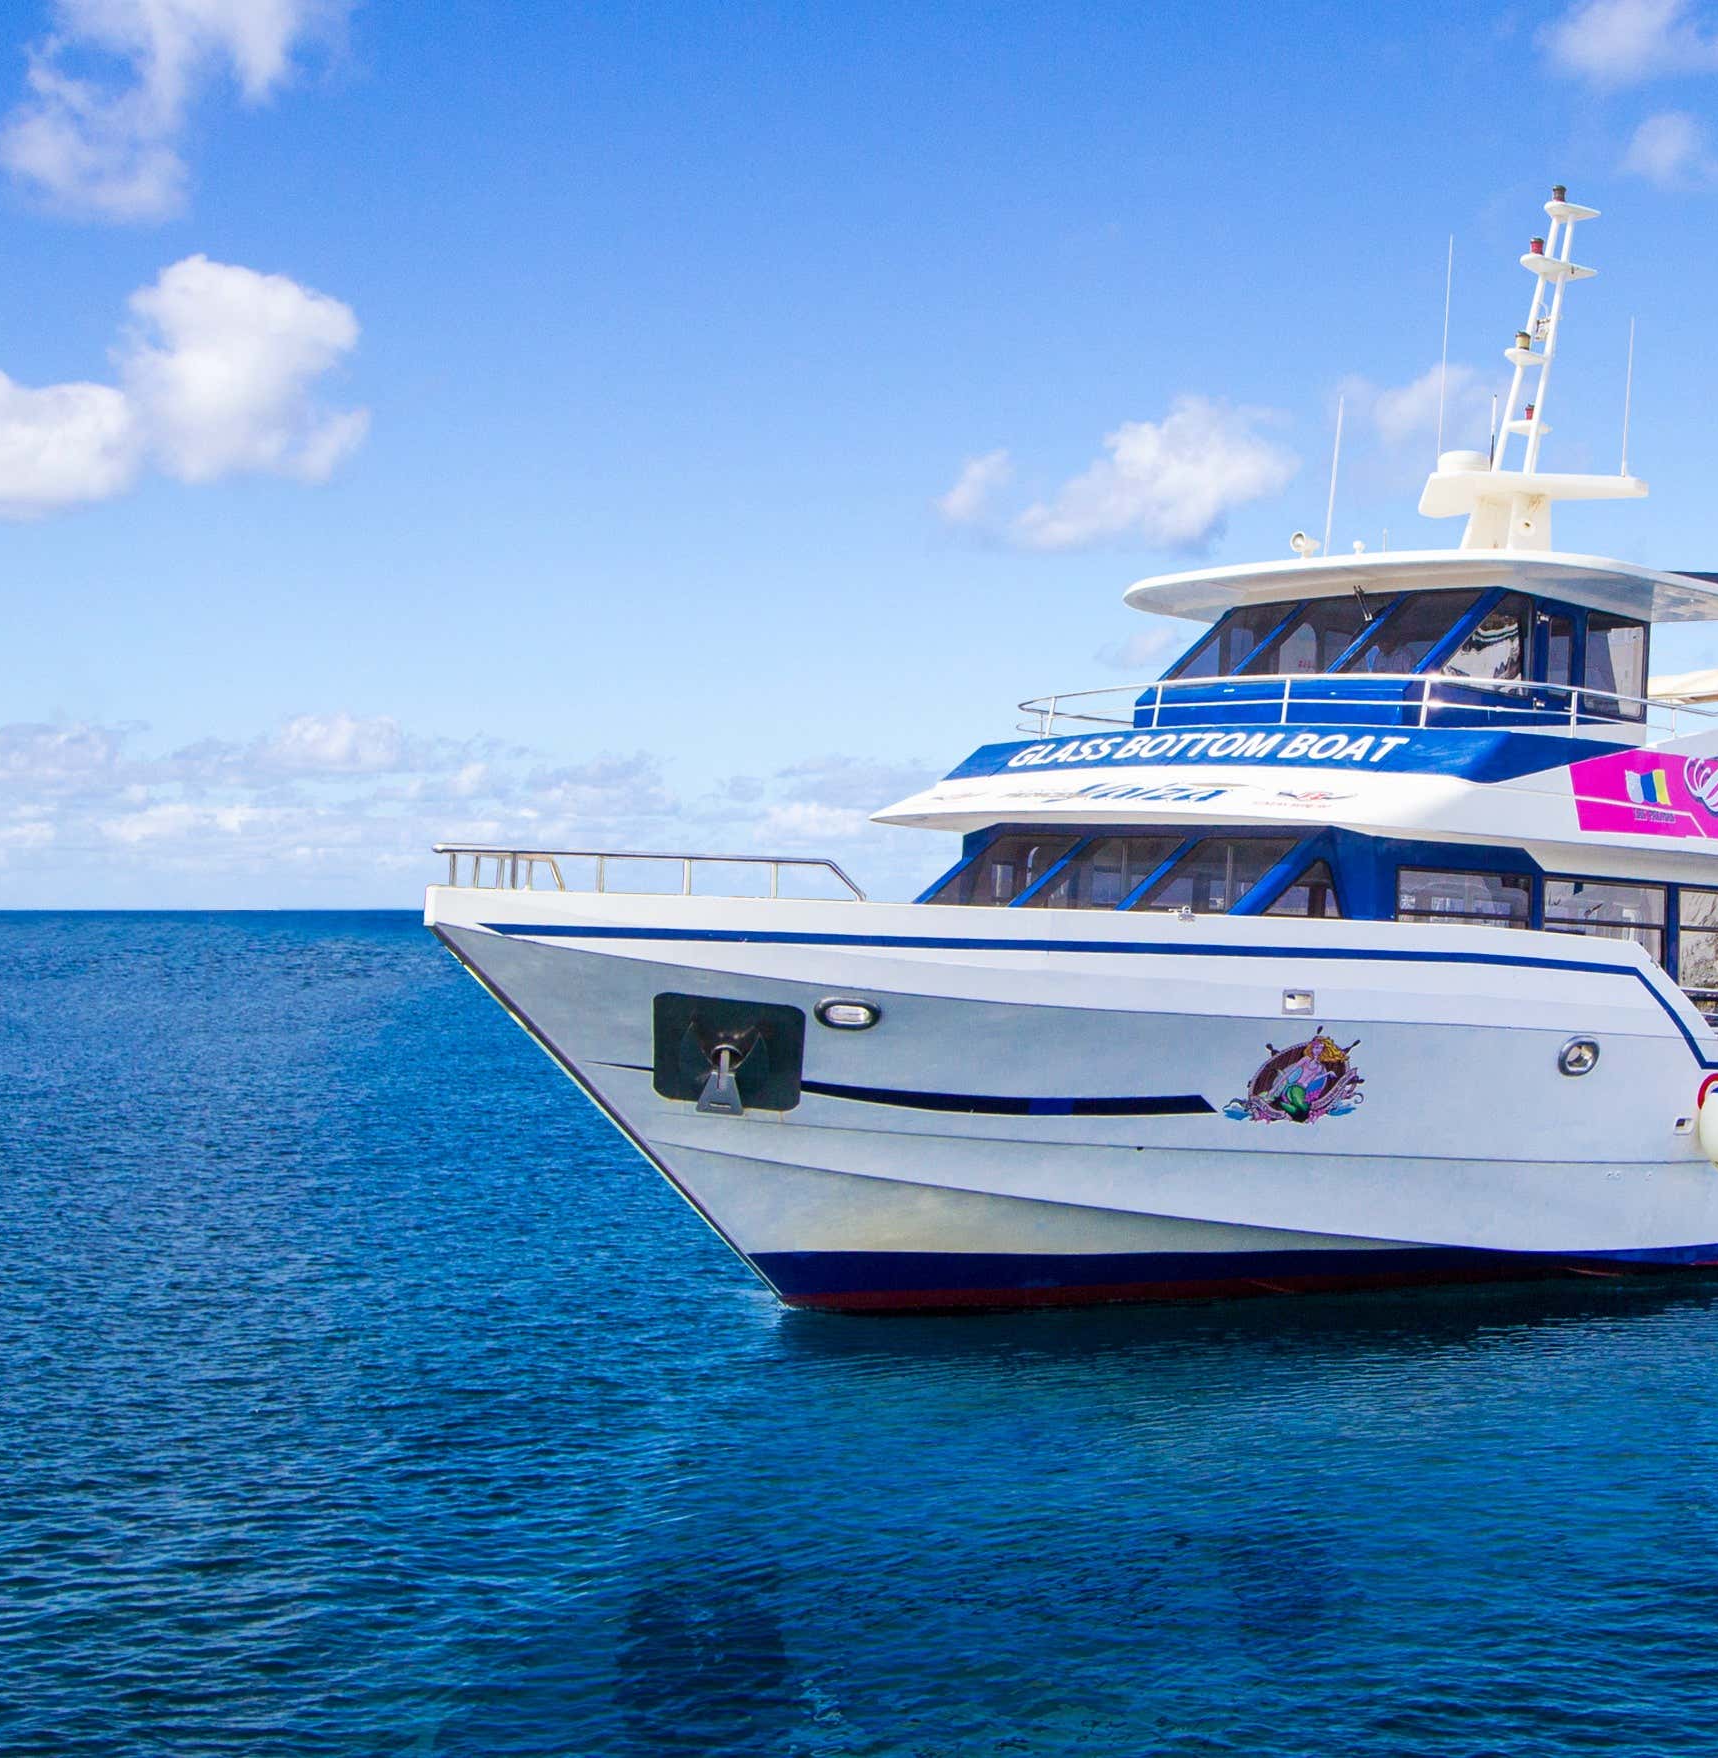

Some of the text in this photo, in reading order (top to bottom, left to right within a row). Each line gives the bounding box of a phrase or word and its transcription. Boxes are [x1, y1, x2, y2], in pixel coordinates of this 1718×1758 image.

[1007, 731, 1409, 767] GLASS BOTTOM BOAT
